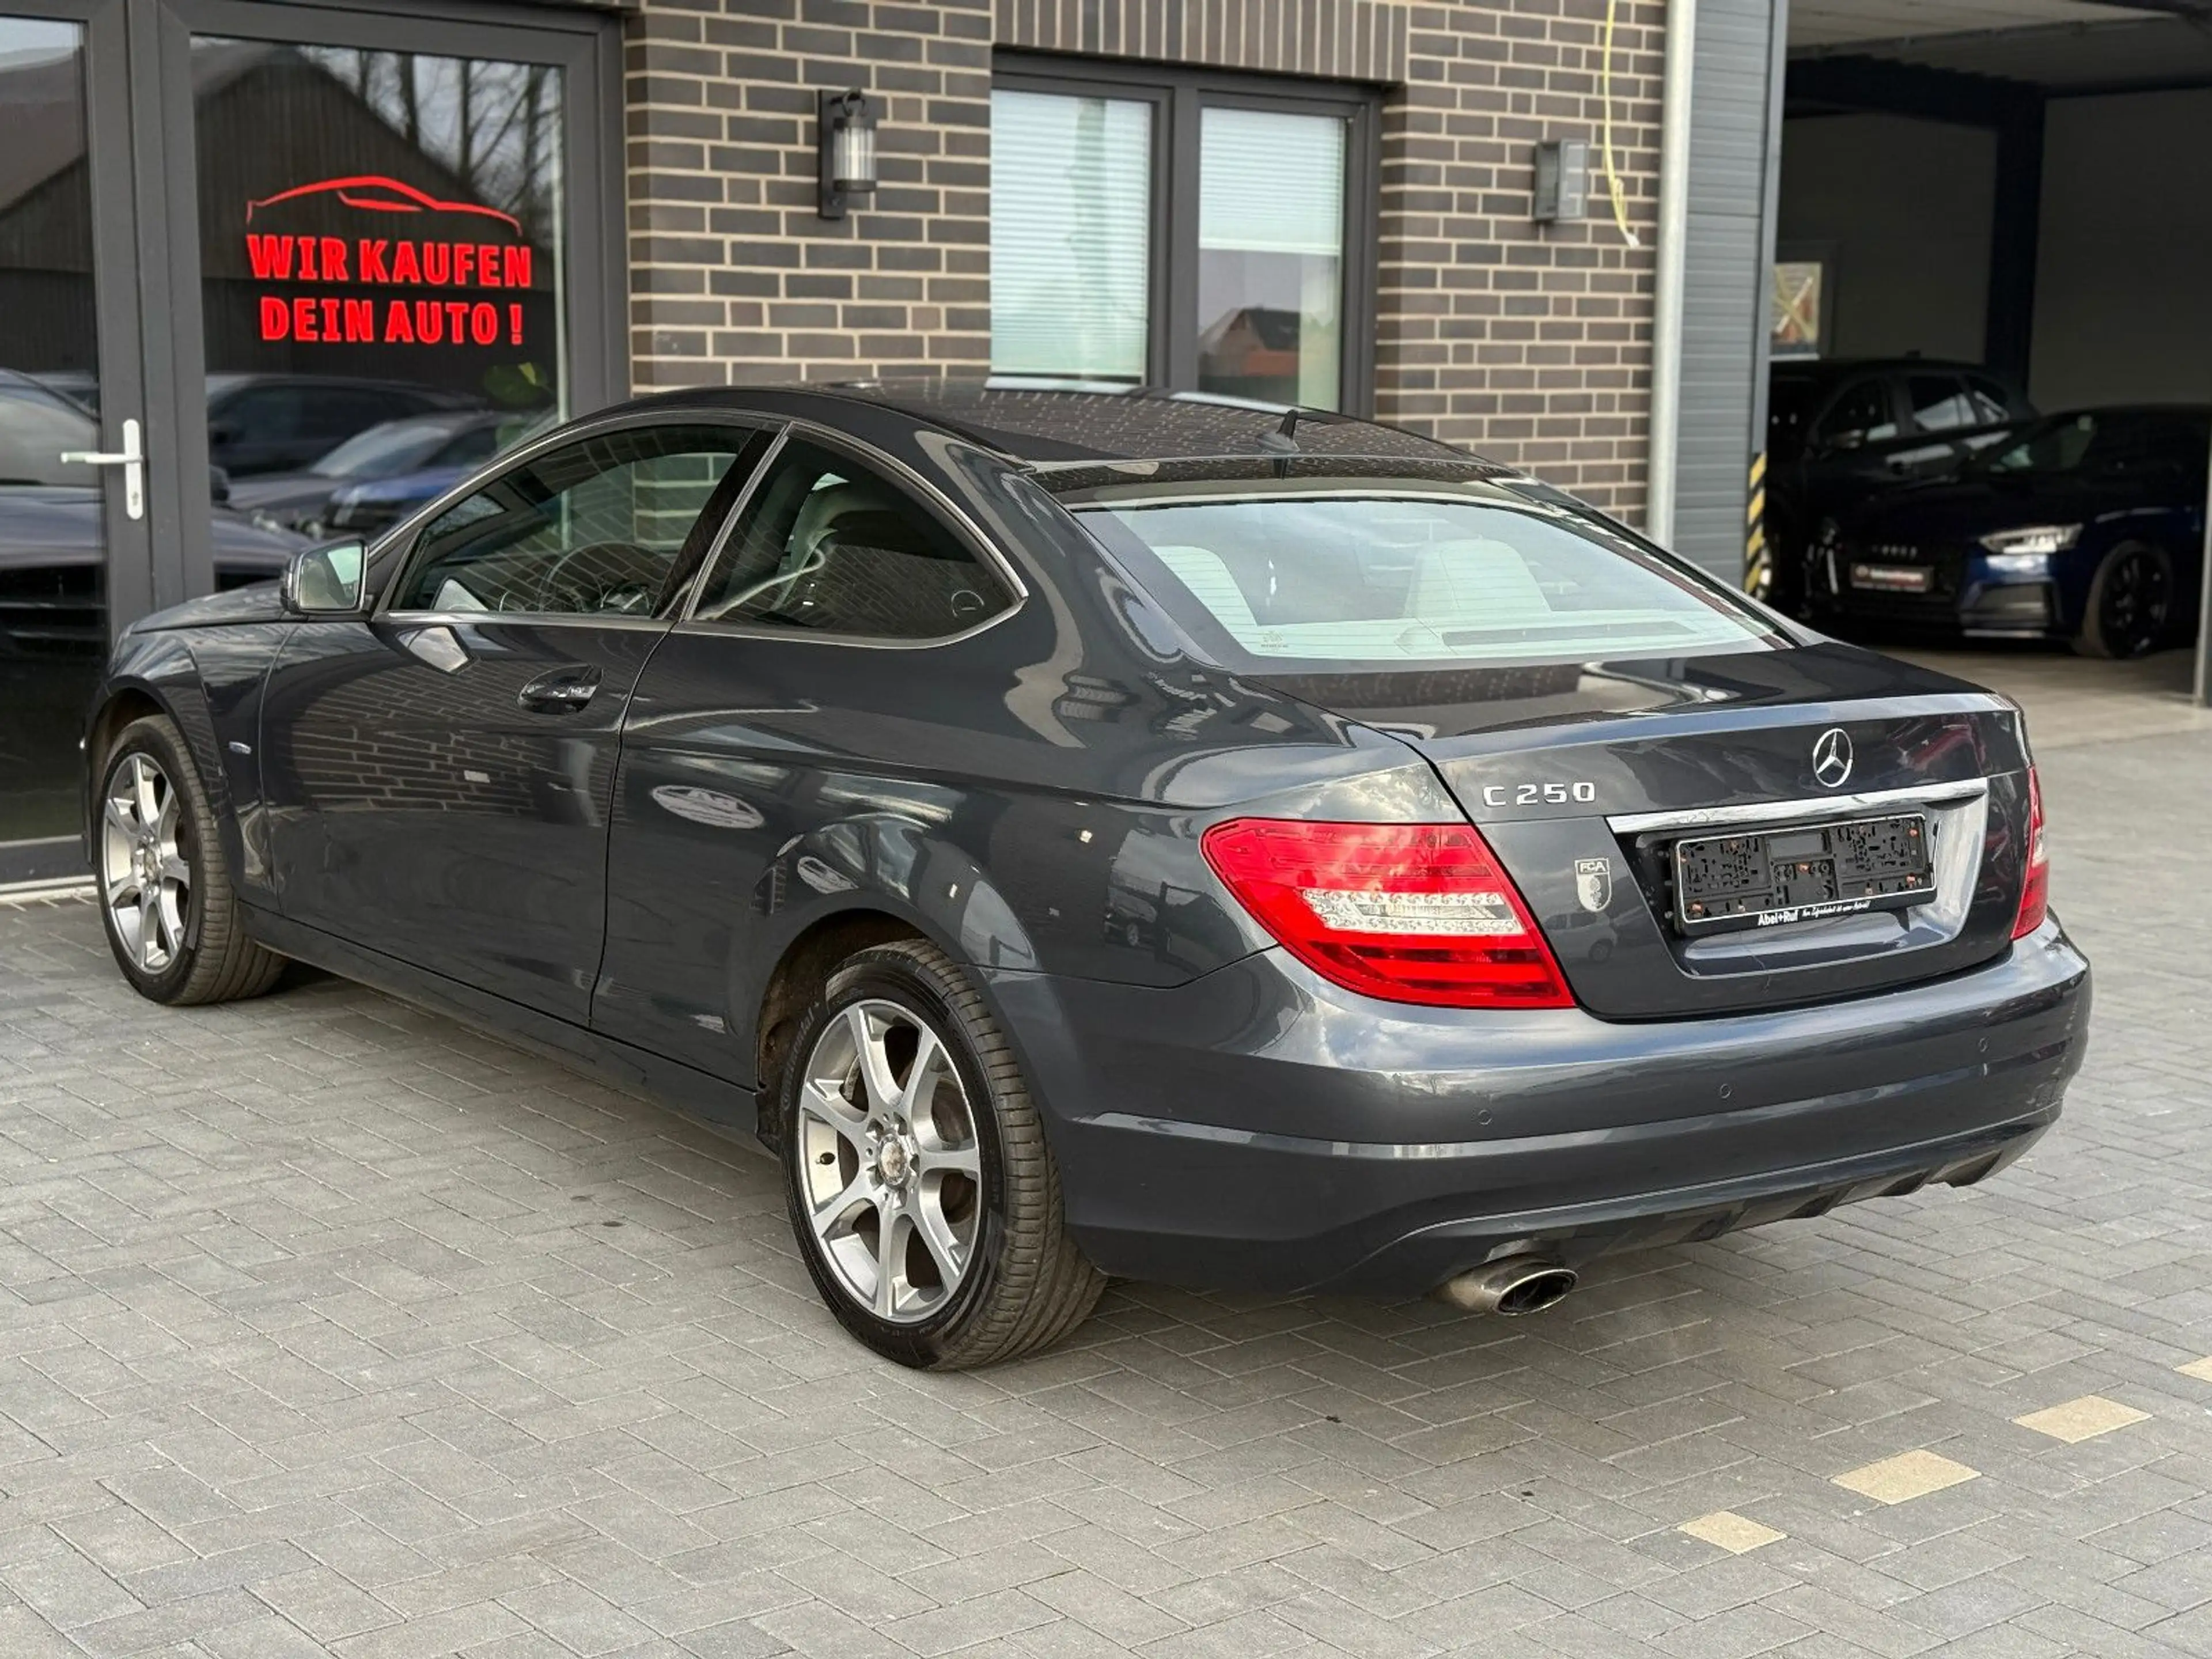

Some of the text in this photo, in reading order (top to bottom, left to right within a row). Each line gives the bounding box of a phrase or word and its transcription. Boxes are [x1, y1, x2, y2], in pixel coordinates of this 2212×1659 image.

[246, 234, 531, 287] WIR KAUFEN
[260, 297, 374, 342] DEIN
[385, 300, 498, 344] AUTO
[1483, 782, 1595, 806] C 250
